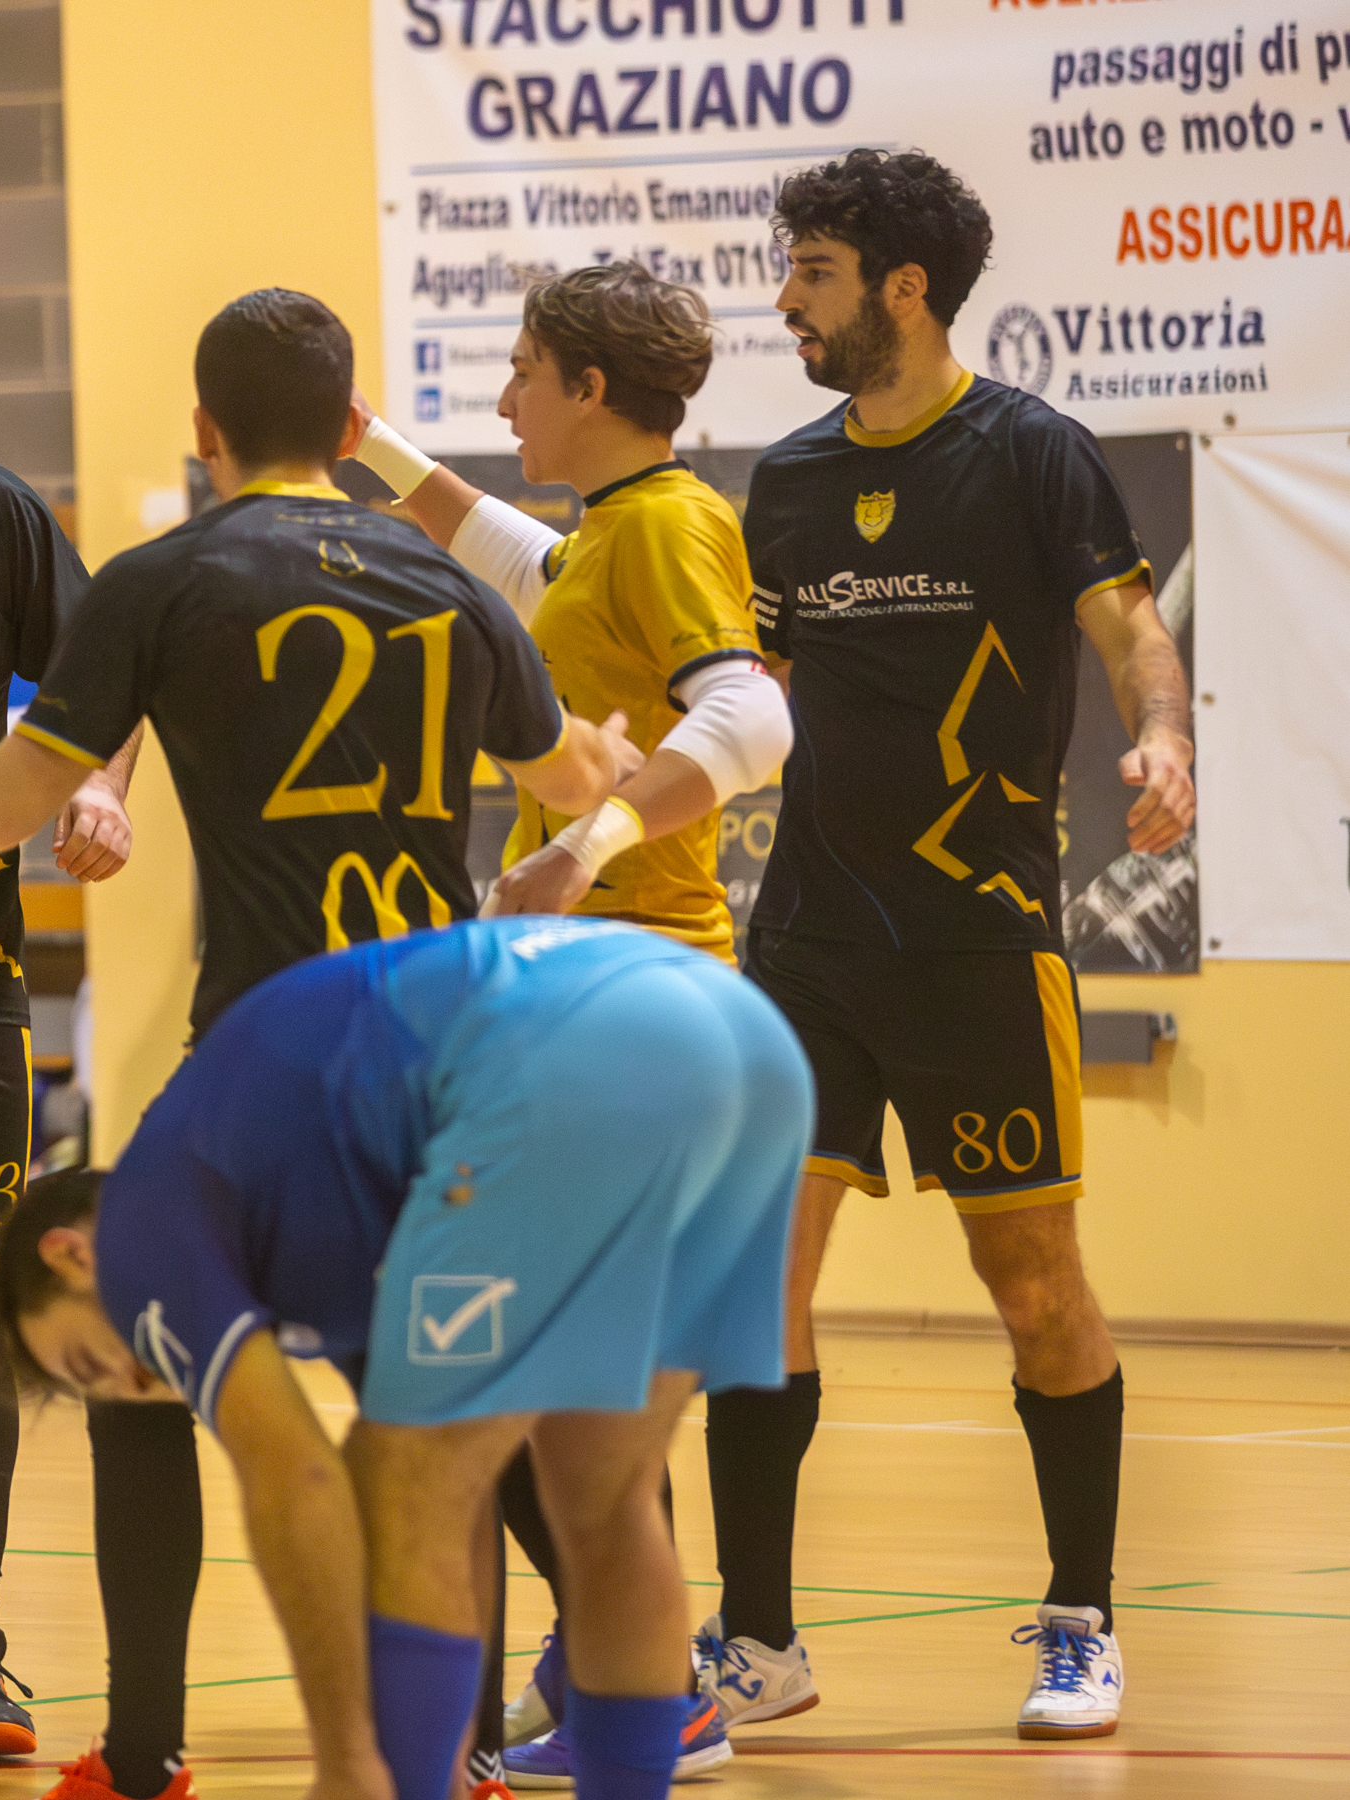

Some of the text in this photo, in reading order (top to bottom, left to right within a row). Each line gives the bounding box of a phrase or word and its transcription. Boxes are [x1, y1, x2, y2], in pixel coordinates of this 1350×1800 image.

[1051, 25, 1246, 102] passaggi
[1259, 22, 1299, 75] di
[466, 57, 853, 142] GRAZIANO
[1030, 108, 1125, 164] auto
[1140, 115, 1166, 156] e
[1181, 98, 1295, 153] moto
[417, 171, 781, 232] Piazza Vittorio Emanuel
[1116, 195, 1350, 265] ASSICURA
[1053, 297, 1265, 355] Vittoria
[1065, 362, 1269, 402] Assicurazioni
[256, 603, 458, 821] 21
[952, 1107, 1042, 1174] 80
